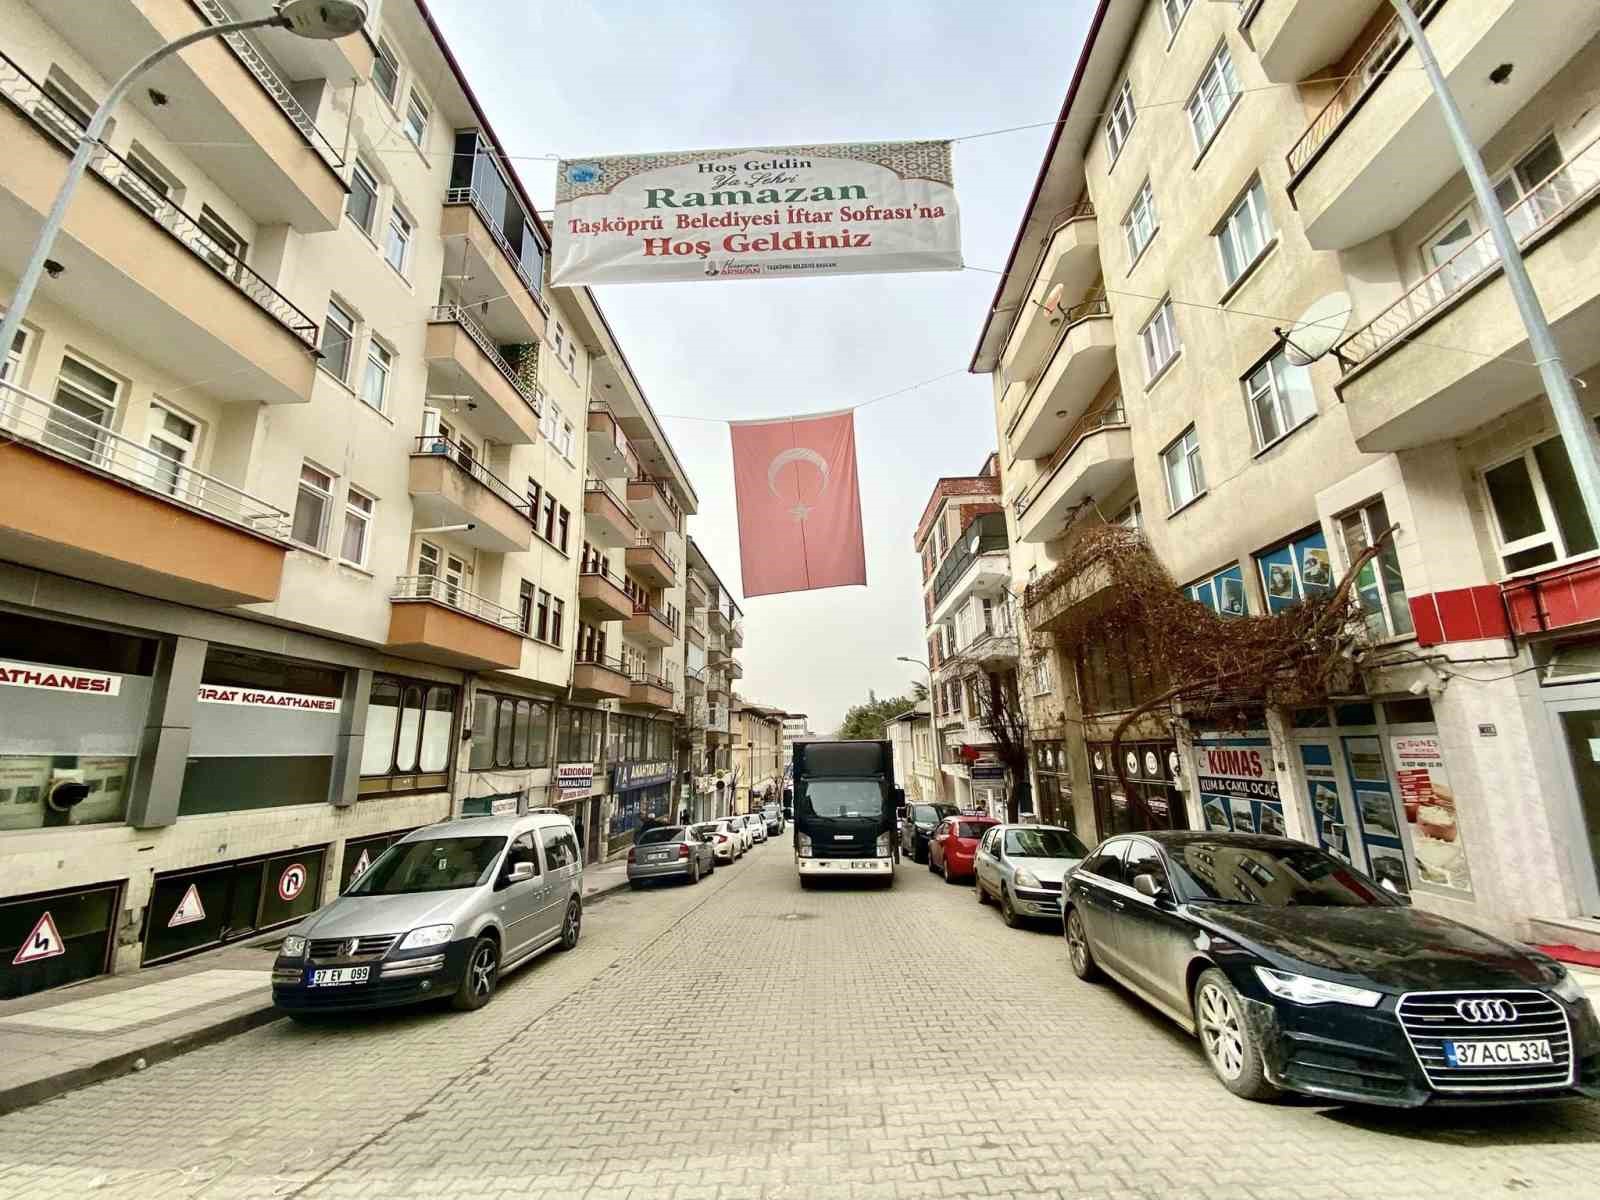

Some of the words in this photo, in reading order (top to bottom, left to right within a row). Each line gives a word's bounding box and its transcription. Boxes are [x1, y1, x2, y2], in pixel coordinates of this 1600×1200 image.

[698, 163, 737, 174] Hoş
[743, 159, 812, 171] Geldin
[644, 183, 868, 209] Ramazan
[568, 216, 664, 236] Taşköprü
[676, 210, 780, 231] Belediyesi
[787, 205, 833, 224] İftar
[840, 203, 945, 222] Sofrası'na
[643, 237, 712, 259] Hoş
[723, 229, 872, 253] Geldiniz
[242, 692, 337, 710] KIRAATHANESİ
[1201, 779, 1218, 792] KUM
[316, 970, 327, 982] 37
[350, 967, 368, 980] 099
[1456, 1045, 1477, 1063] 37
[1482, 1043, 1521, 1063] ACL
[1521, 1041, 1550, 1060] 334
